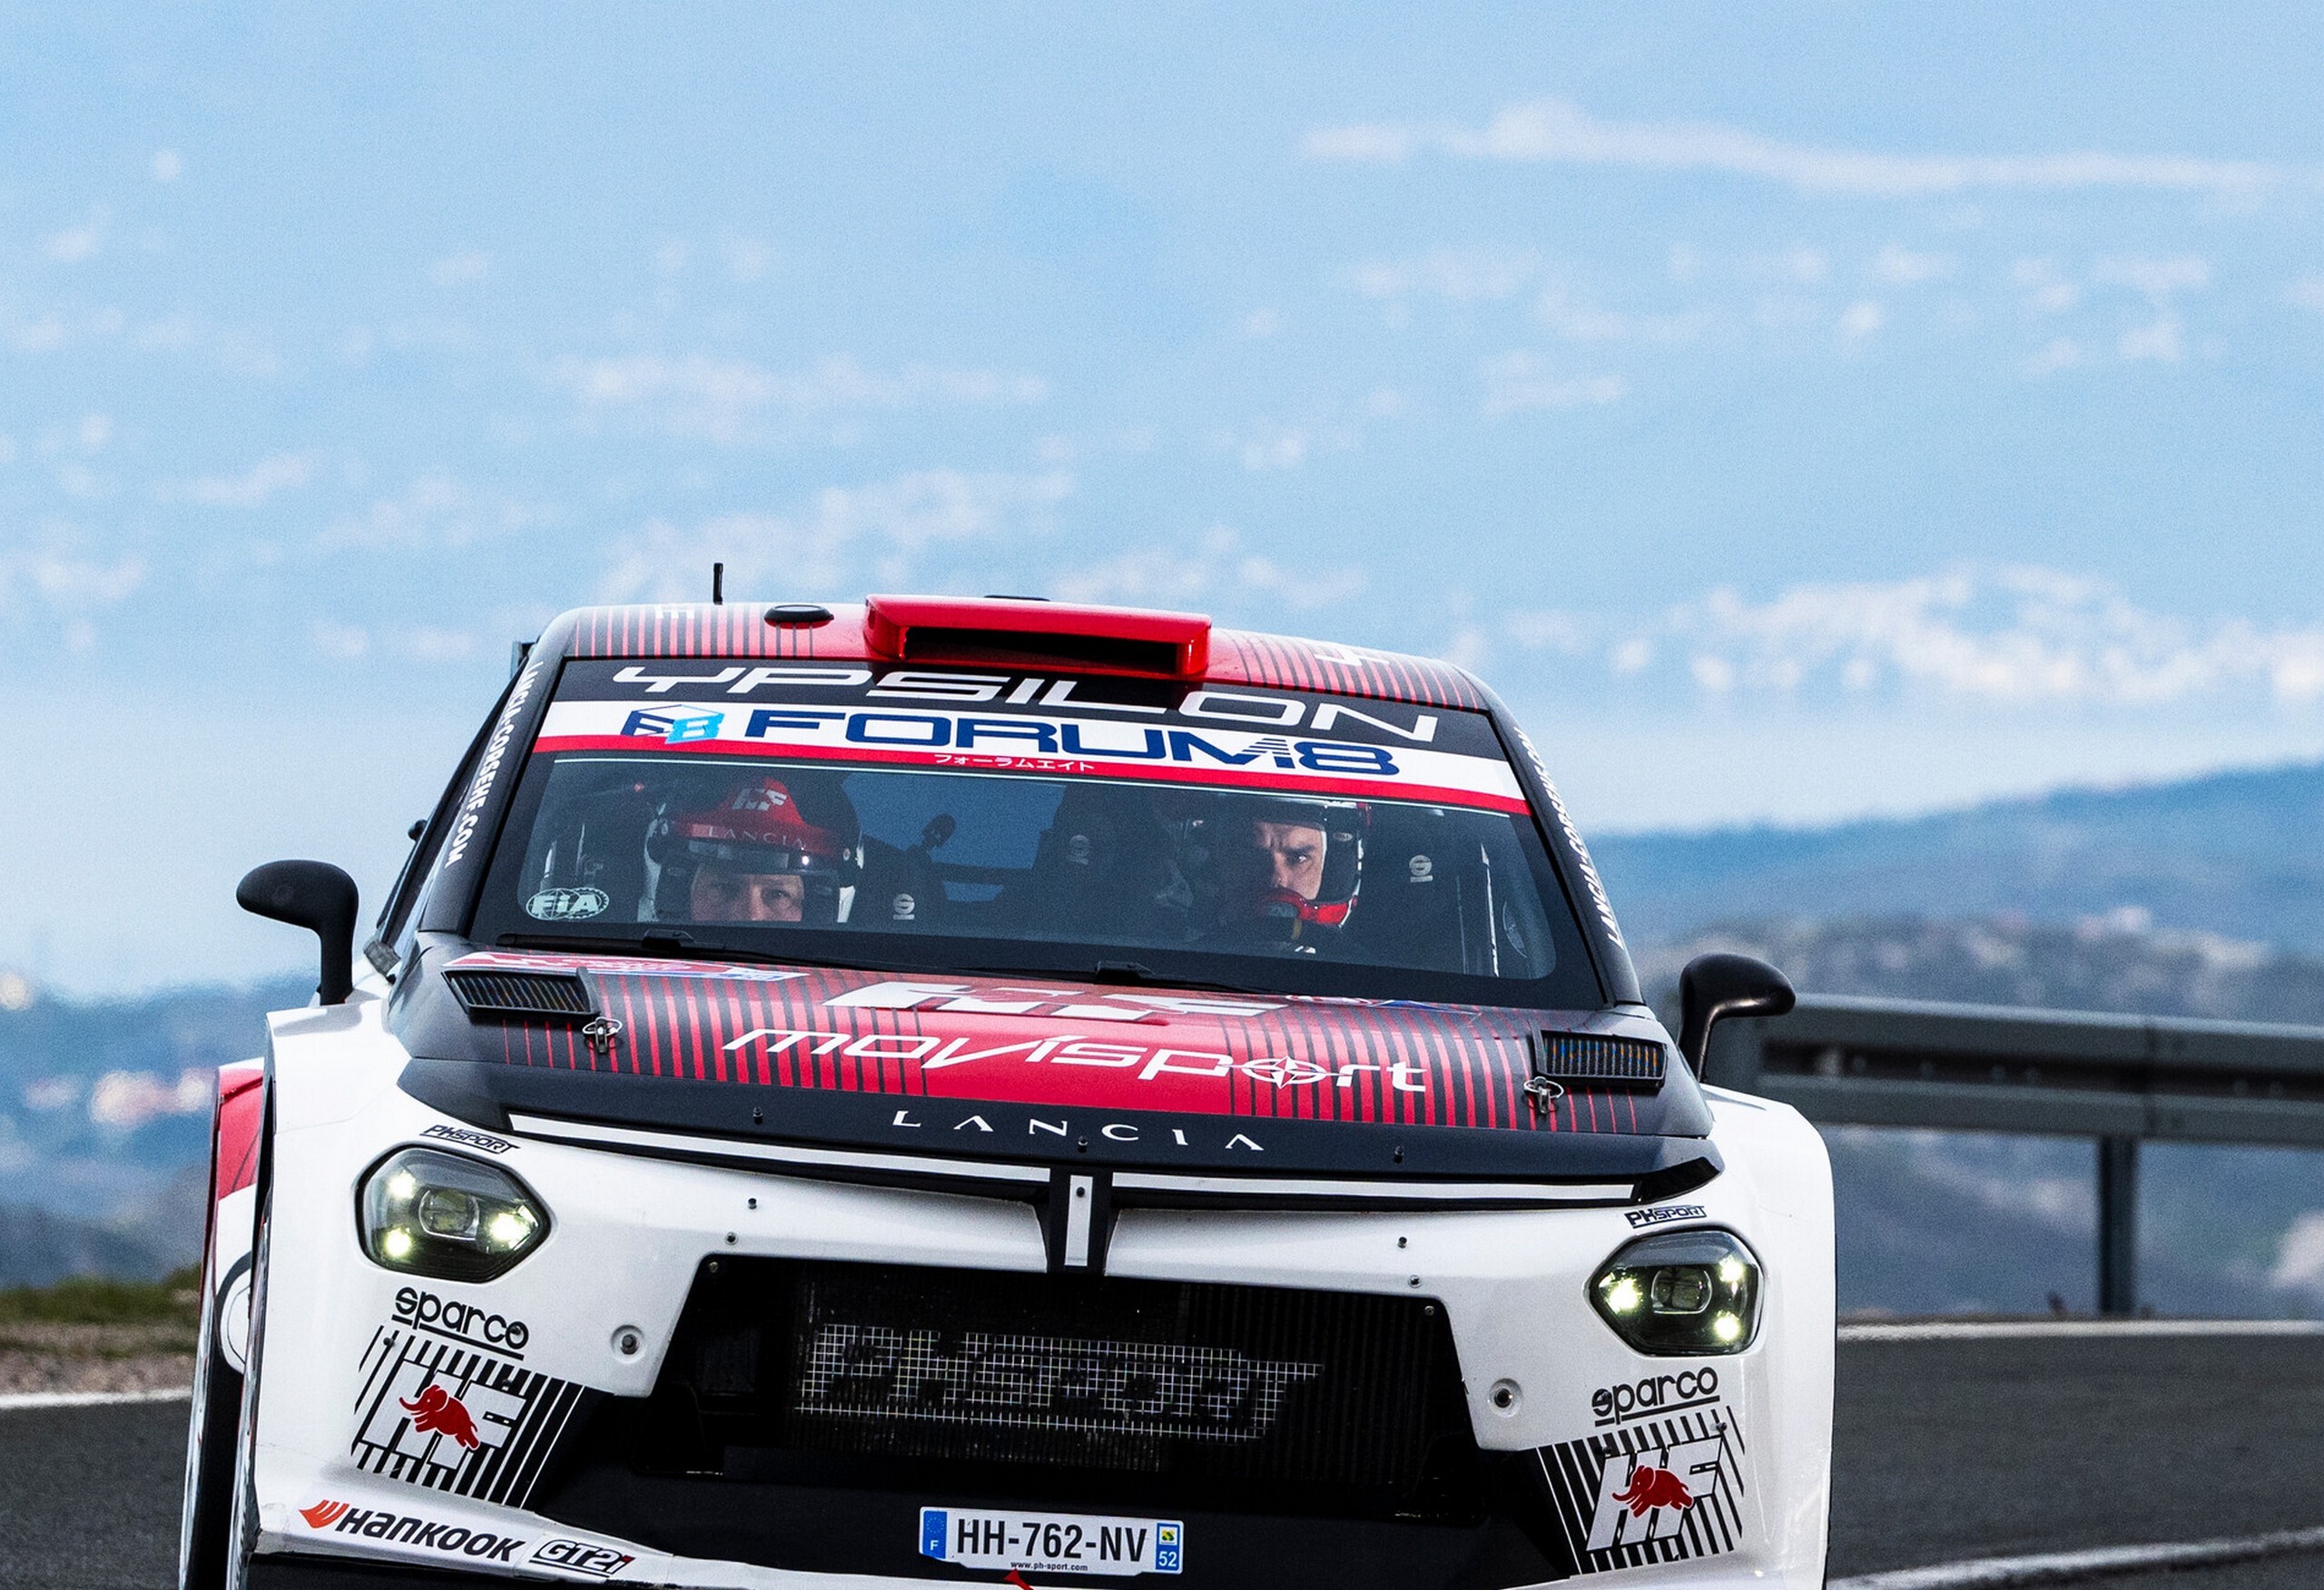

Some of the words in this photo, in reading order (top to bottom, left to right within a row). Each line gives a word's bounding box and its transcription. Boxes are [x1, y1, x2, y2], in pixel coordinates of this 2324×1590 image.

[613, 667, 1438, 742] YPSILON
[745, 709, 1401, 776] FORUM8
[934, 754, 1095, 771] フォーラムエイト
[892, 1109, 1265, 1152] LANCIA
[393, 1287, 529, 1354] sparco
[1591, 1367, 1719, 1426] sparco
[930, 1540, 939, 1551] F
[957, 1518, 1147, 1563] HH-762-NV
[1158, 1551, 1177, 1567] 52
[1010, 1562, 1088, 1572] www.ph-sport.com
